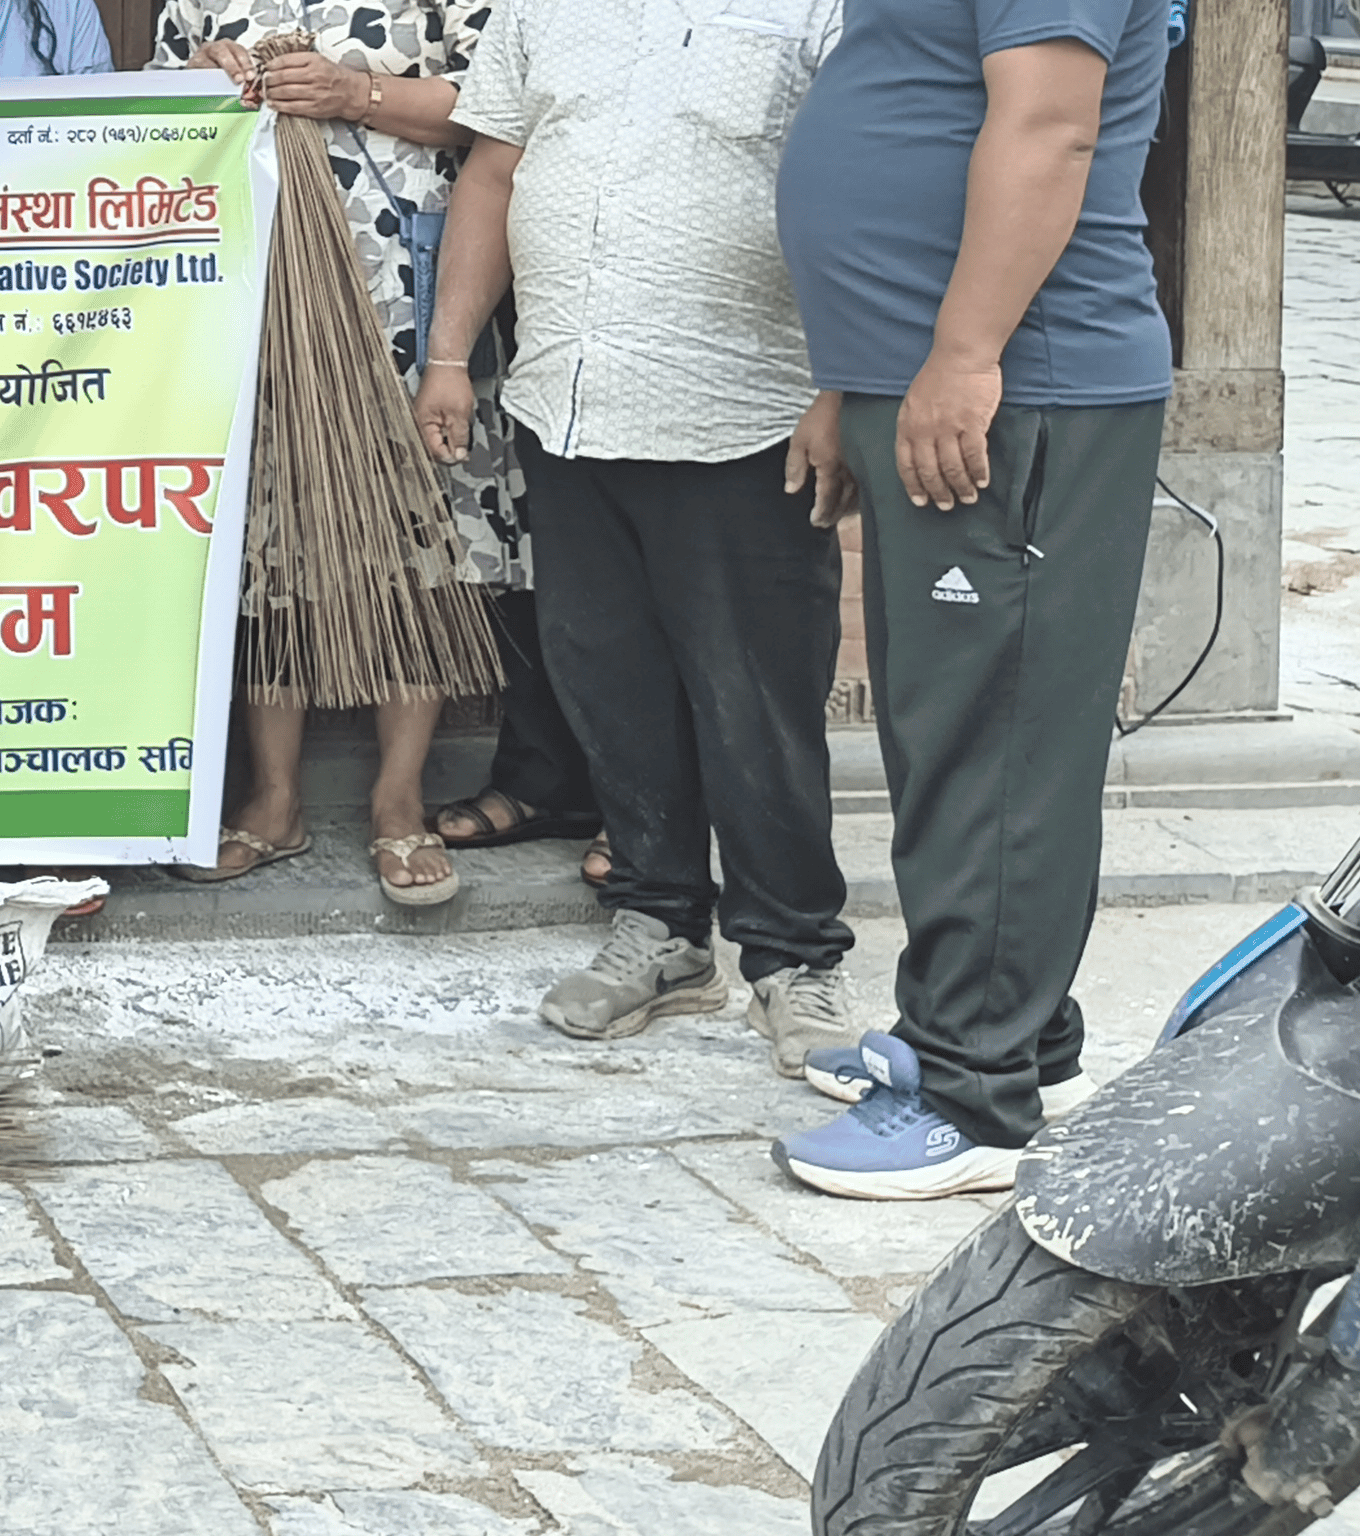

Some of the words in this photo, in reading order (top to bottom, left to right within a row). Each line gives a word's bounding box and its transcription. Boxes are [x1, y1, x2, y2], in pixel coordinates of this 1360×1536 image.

[7, 125, 34, 144] दर्ता
[67, 130, 96, 143] २८२
[88, 177, 218, 227] लिमिटेड
[75, 257, 168, 290] Society
[176, 253, 223, 283] Ltd.
